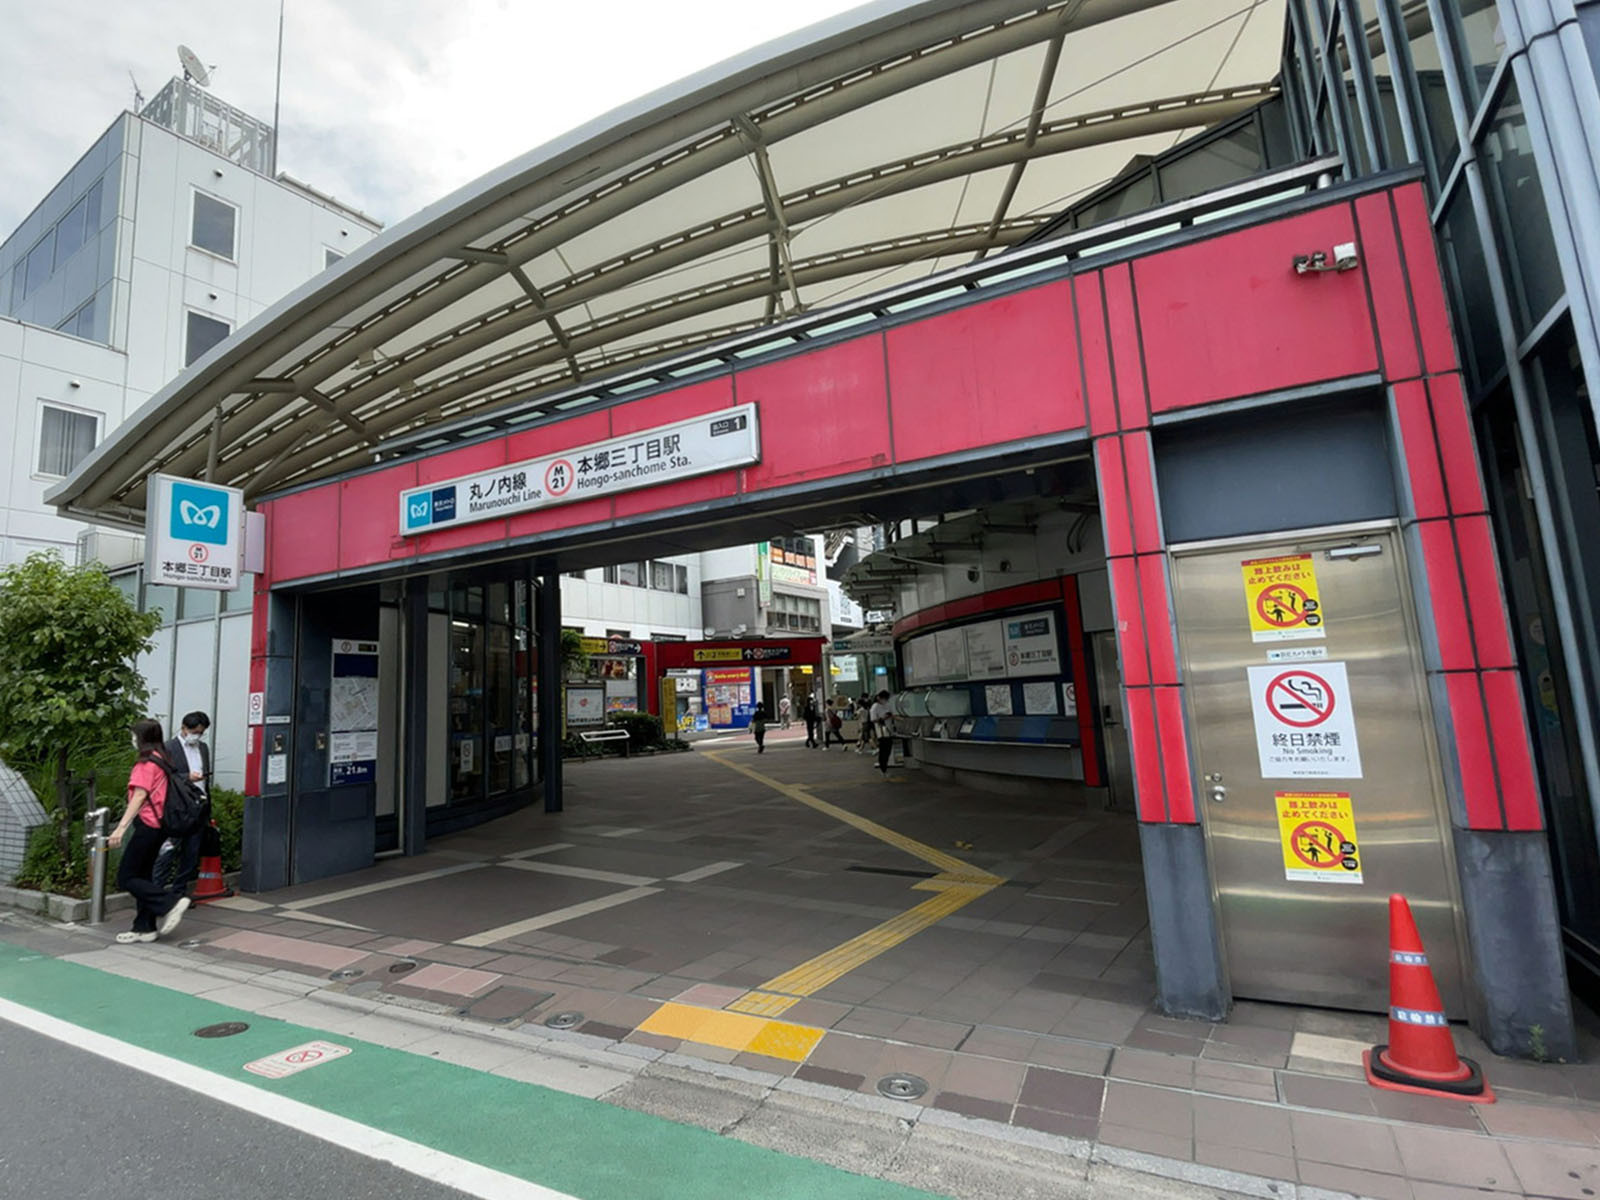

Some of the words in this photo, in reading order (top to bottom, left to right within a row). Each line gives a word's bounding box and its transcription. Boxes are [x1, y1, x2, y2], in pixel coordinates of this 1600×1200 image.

[734, 418, 740, 429] 1
[577, 434, 680, 475] 本郷三丁目駅
[554, 466, 564, 476] M
[577, 460, 667, 490] Hongo-sanchome
[670, 456, 692, 469] Sta.
[469, 472, 527, 500] 丸ノ内線
[552, 477, 565, 489] 21
[469, 490, 521, 513] Marunouchi
[523, 488, 542, 502] Line
[162, 561, 232, 578] 本郷三丁目駅
[1248, 572, 1311, 585] 止めてください
[1272, 732, 1341, 747] 終日禁煙
[1297, 747, 1333, 755] Smoking
[1282, 811, 1348, 819] 止めてください
